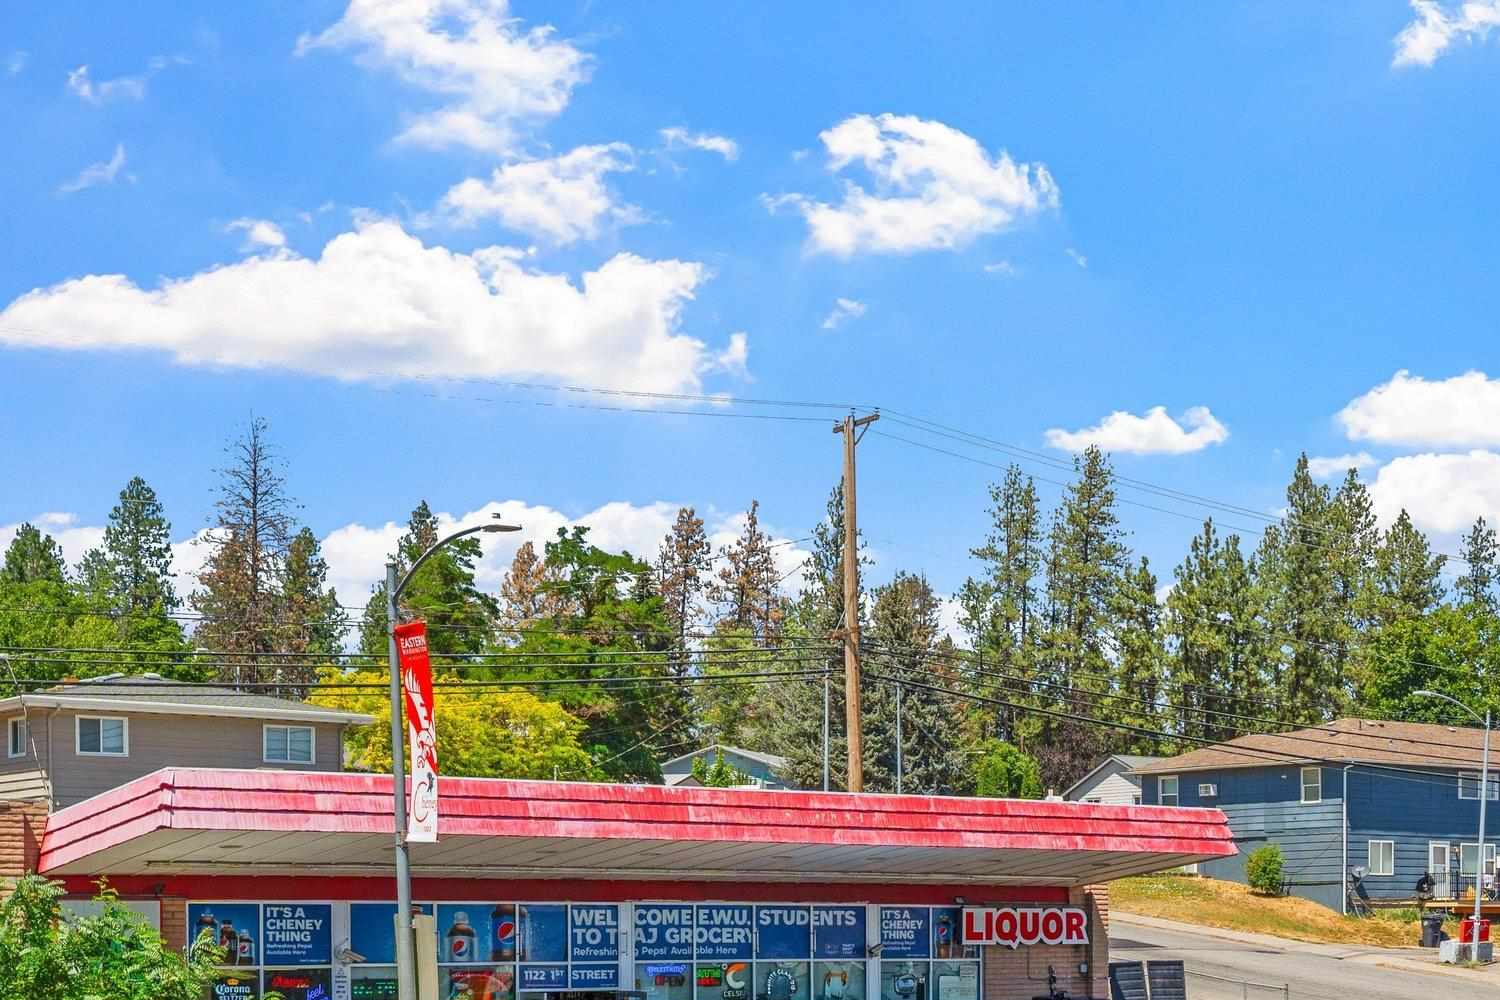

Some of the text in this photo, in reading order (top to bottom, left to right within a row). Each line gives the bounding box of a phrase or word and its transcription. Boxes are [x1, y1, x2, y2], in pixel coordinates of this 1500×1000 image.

[266, 907, 305, 918] IT'S A
[760, 909, 857, 926] STUDENTS
[882, 910, 910, 919] IT'S A
[266, 919, 323, 930] CHENEY
[882, 920, 923, 930] CHENEY
[964, 910, 1086, 945] LIQUOR
[266, 931, 311, 942] THING
[573, 928, 602, 944] TO
[665, 928, 753, 944] GROCERY
[882, 930, 914, 940] THING
[716, 947, 737, 955] Here
[524, 970, 545, 980] 1122
[572, 970, 615, 980] STREET
[215, 984, 250, 994] Corona
